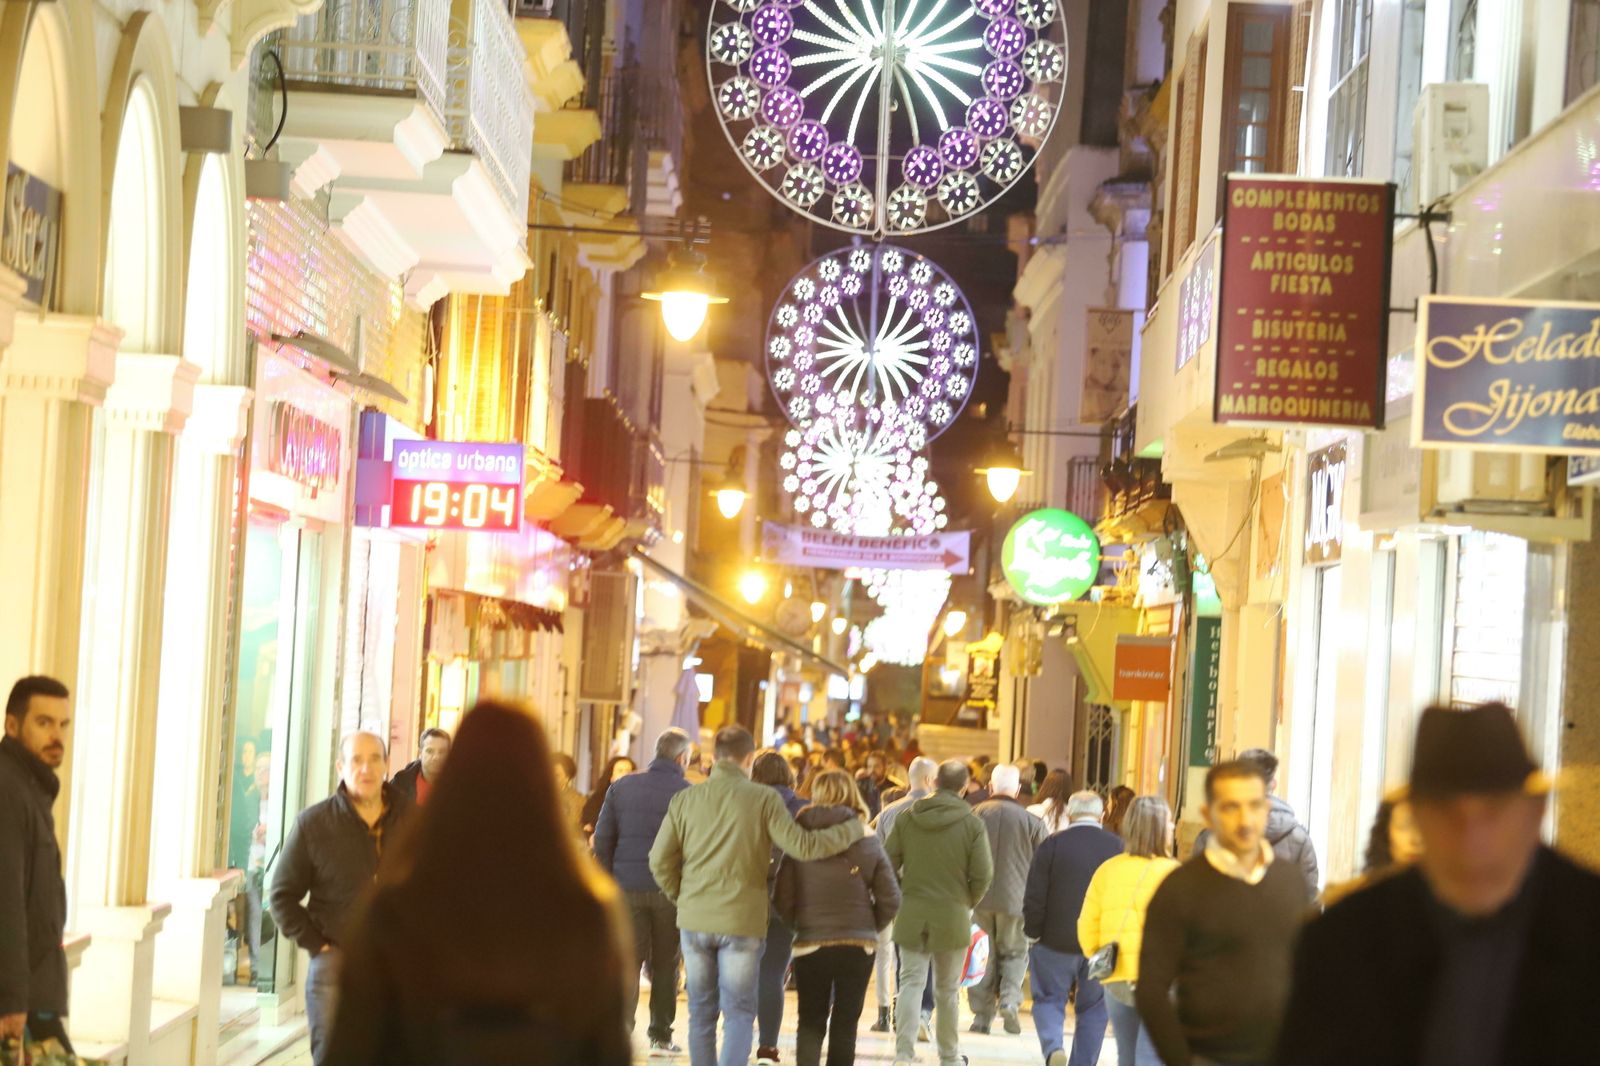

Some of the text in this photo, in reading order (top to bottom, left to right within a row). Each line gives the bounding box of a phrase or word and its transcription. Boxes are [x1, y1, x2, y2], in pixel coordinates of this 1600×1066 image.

[1231, 187, 1380, 214] COMPLEMENTOS
[1272, 211, 1336, 233] BODAS
[1250, 251, 1355, 275] ARTICULOS
[1270, 273, 1333, 296] FIESTA
[1252, 319, 1347, 343] BISUTERIA
[1256, 357, 1339, 381] REGALOS
[1219, 393, 1371, 420] MARROQUINERIA
[457, 449, 517, 473] urbano
[410, 482, 516, 528] 19:04
